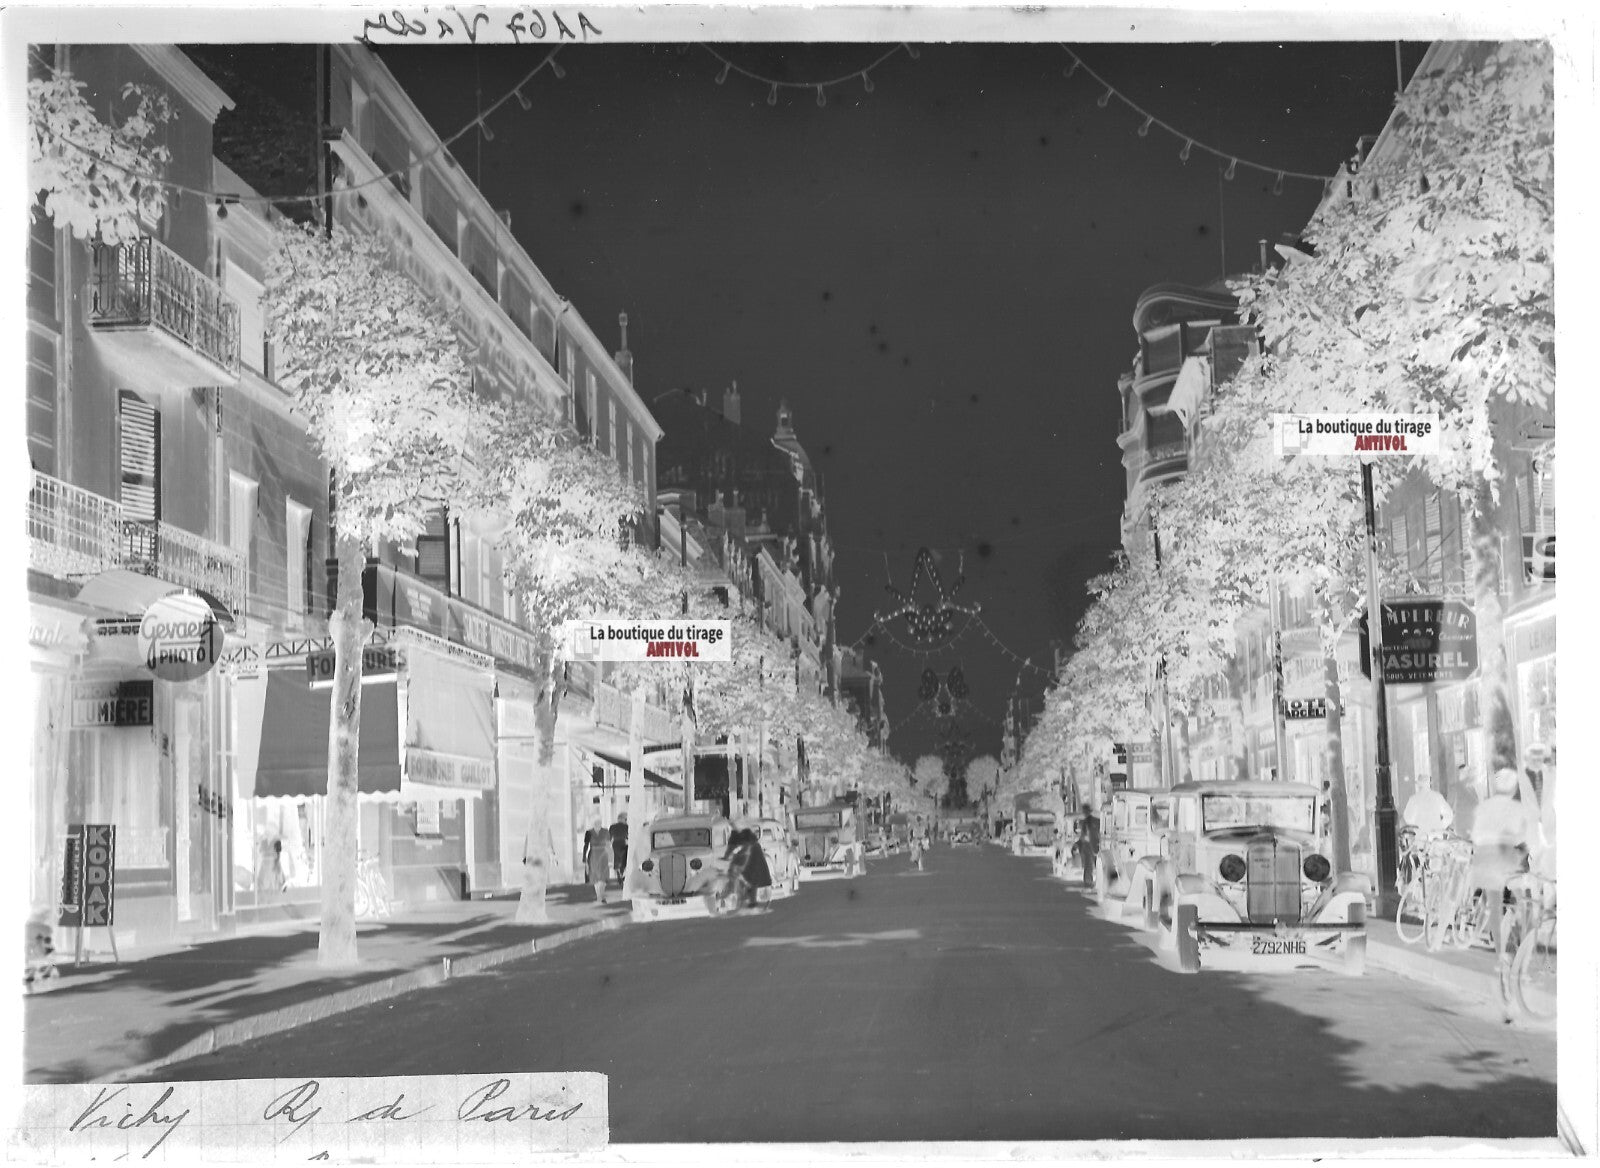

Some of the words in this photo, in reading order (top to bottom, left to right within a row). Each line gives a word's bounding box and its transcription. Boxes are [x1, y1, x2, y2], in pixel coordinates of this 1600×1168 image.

[1386, 608, 1470, 629] MPEREUR
[160, 646, 206, 664] PHOTO
[310, 650, 407, 676] FOURES
[1384, 652, 1469, 669] ASUREL
[87, 826, 108, 925] KODAK
[70, 1086, 190, 1158] Vichy
[458, 1079, 583, 1122] Paris
